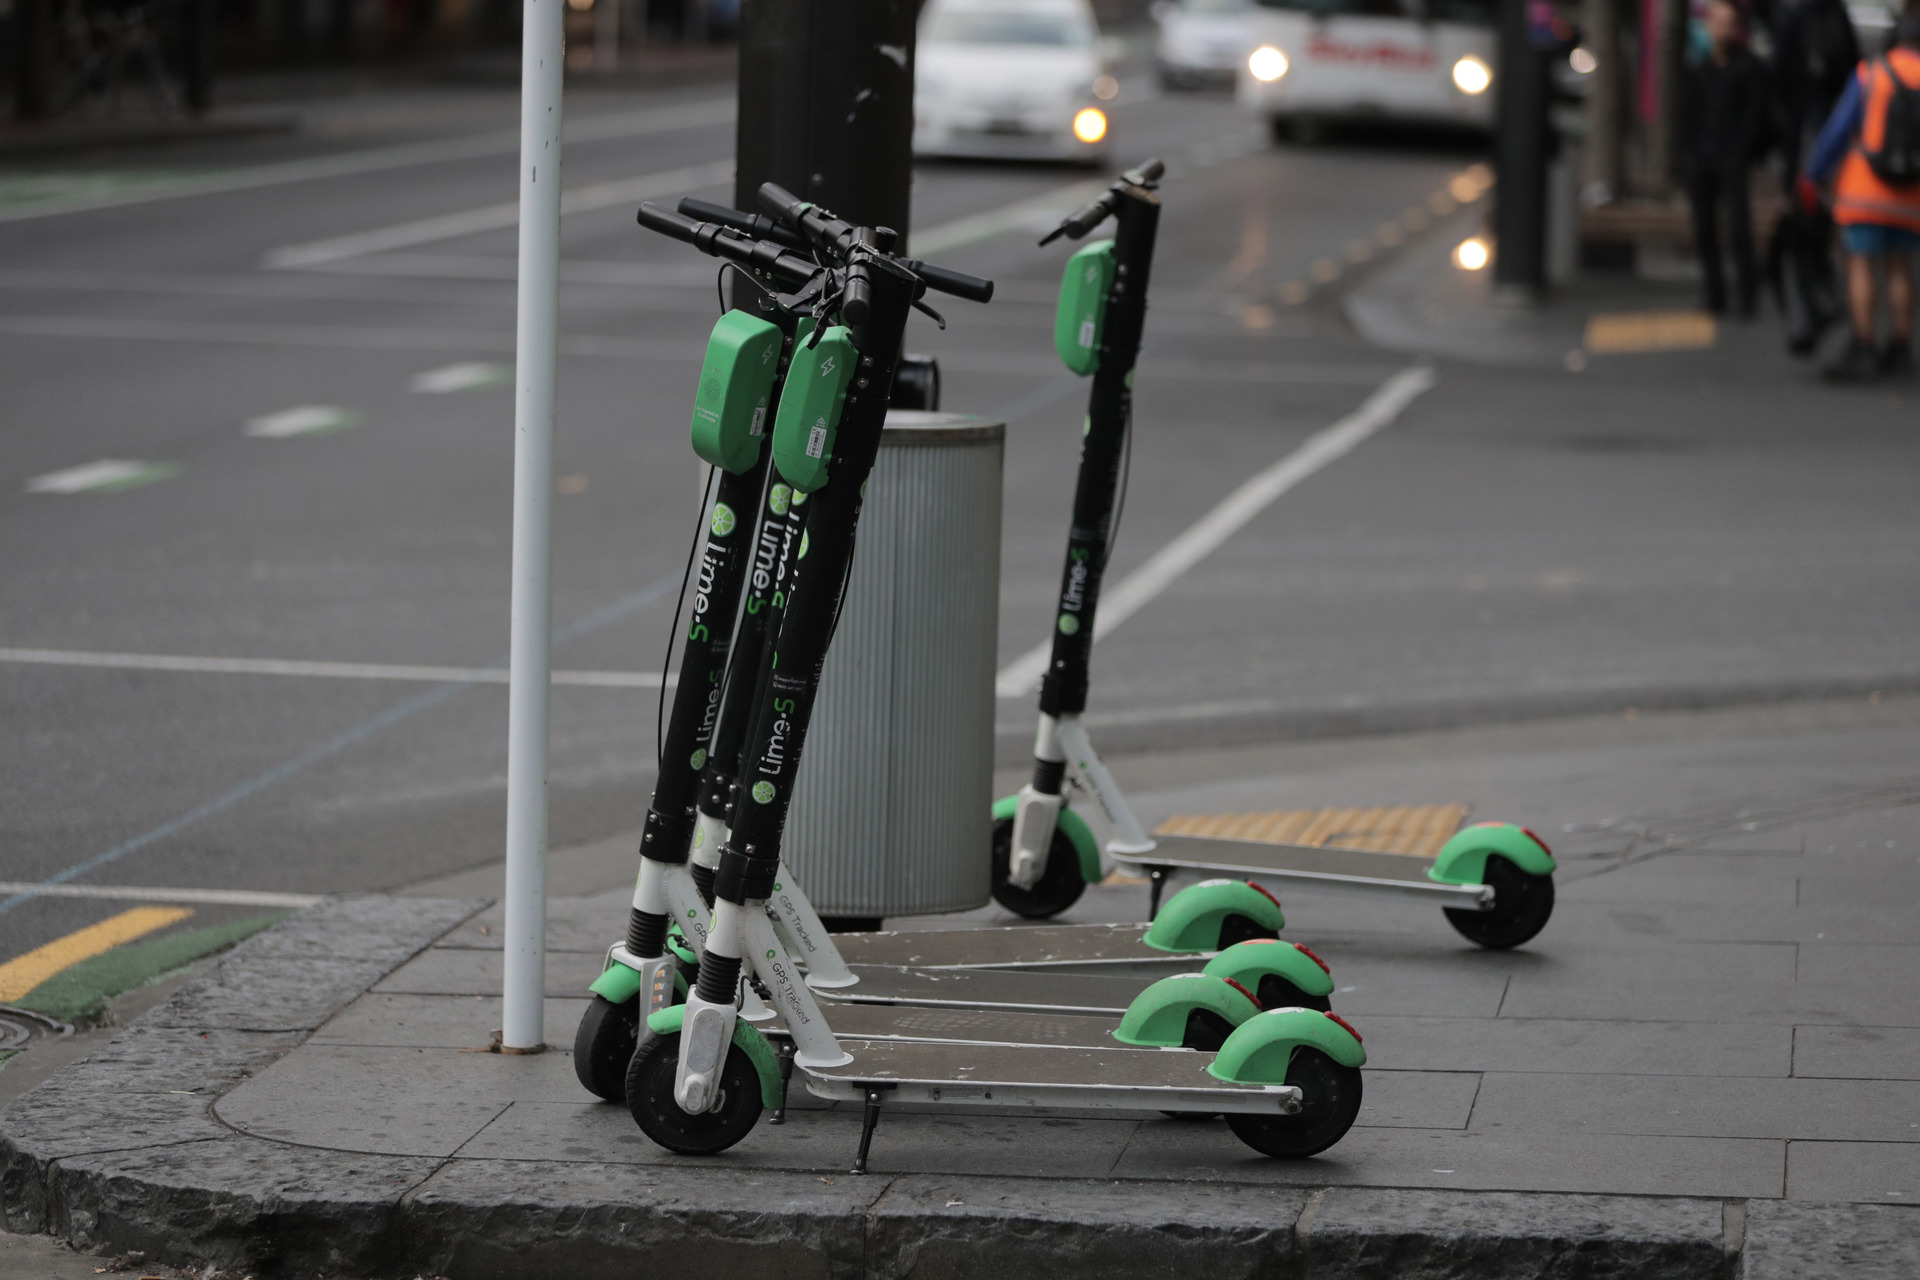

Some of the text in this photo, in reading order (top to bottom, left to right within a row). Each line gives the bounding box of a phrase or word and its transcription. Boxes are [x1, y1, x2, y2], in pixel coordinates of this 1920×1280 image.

[779, 895, 818, 953] GPS Tracked
[772, 962, 789, 986] GPS
